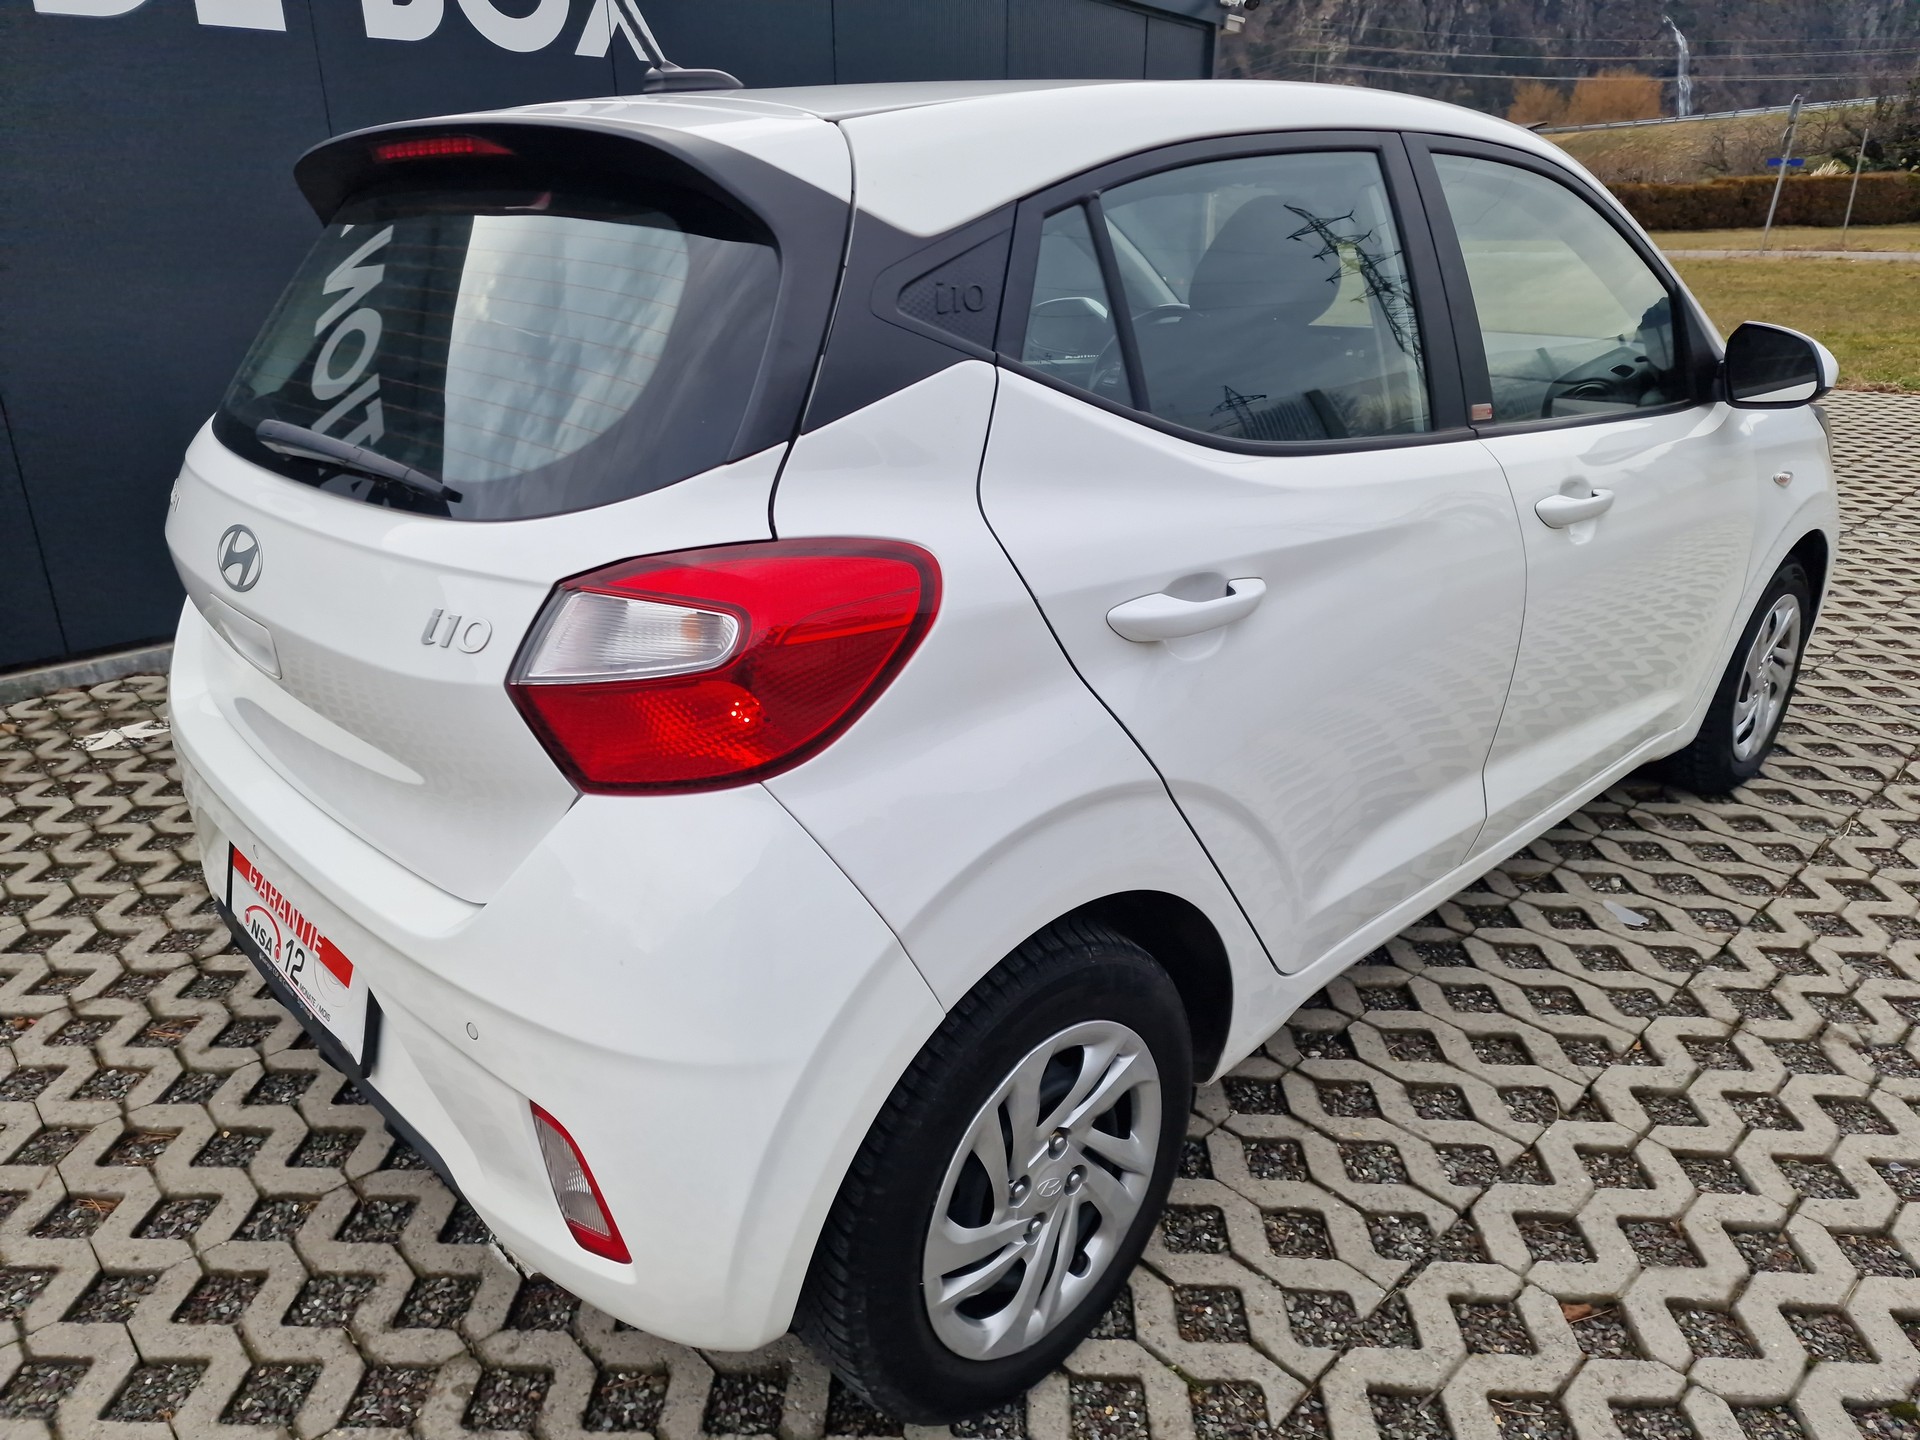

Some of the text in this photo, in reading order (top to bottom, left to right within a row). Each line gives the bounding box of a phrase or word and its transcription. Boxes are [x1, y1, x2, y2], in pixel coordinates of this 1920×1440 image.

[935, 282, 985, 315] i10
[421, 607, 493, 654] i10
[248, 863, 323, 960] GARANTIE
[251, 918, 273, 957] NSA
[285, 938, 306, 988] 12
